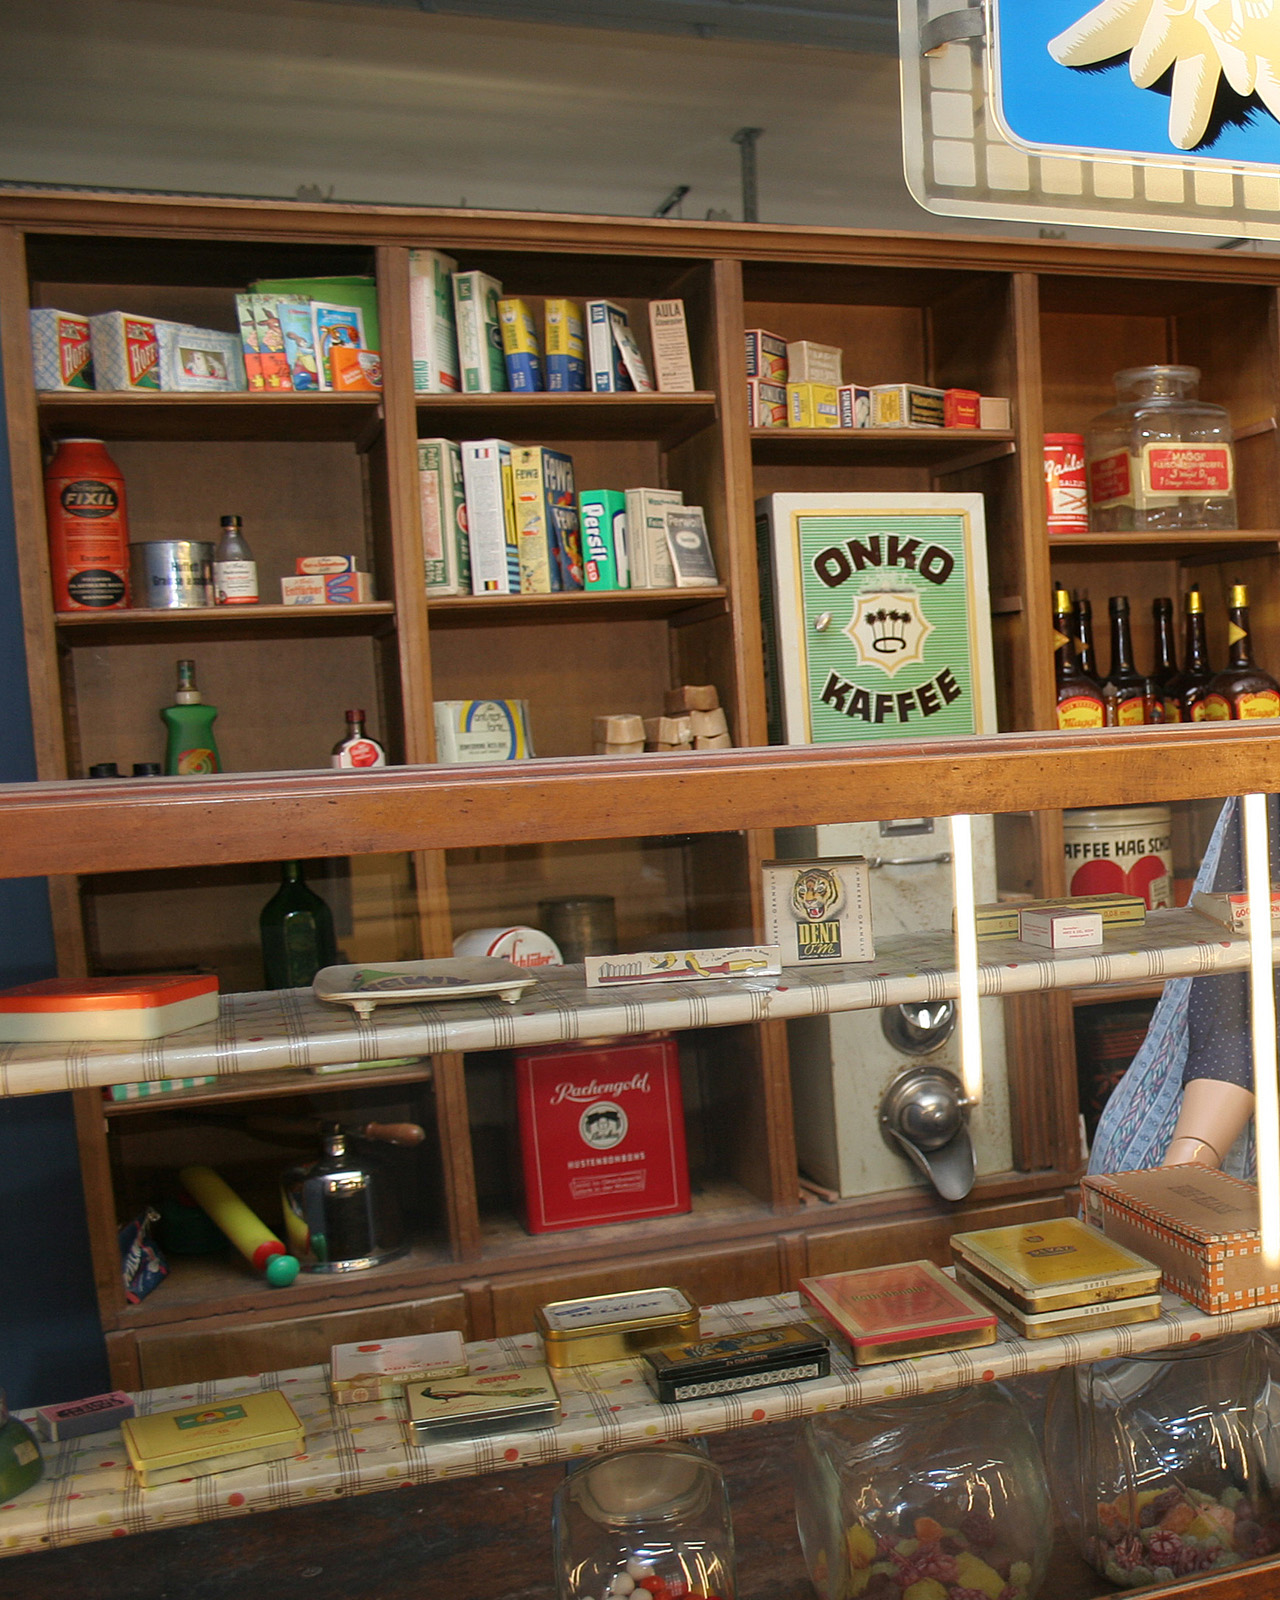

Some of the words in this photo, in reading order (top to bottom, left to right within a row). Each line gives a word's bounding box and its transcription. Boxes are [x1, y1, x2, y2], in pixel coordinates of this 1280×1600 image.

[656, 303, 681, 317] AULA
[65, 493, 115, 506] FIXIL
[582, 503, 608, 561] Persil
[813, 533, 954, 588] ONKO
[820, 668, 962, 723] KAFFEE
[1064, 842, 1109, 859] AFFEE
[1115, 840, 1145, 856] HAG
[798, 922, 839, 945] DENT
[550, 1072, 650, 1105] Rachengold
